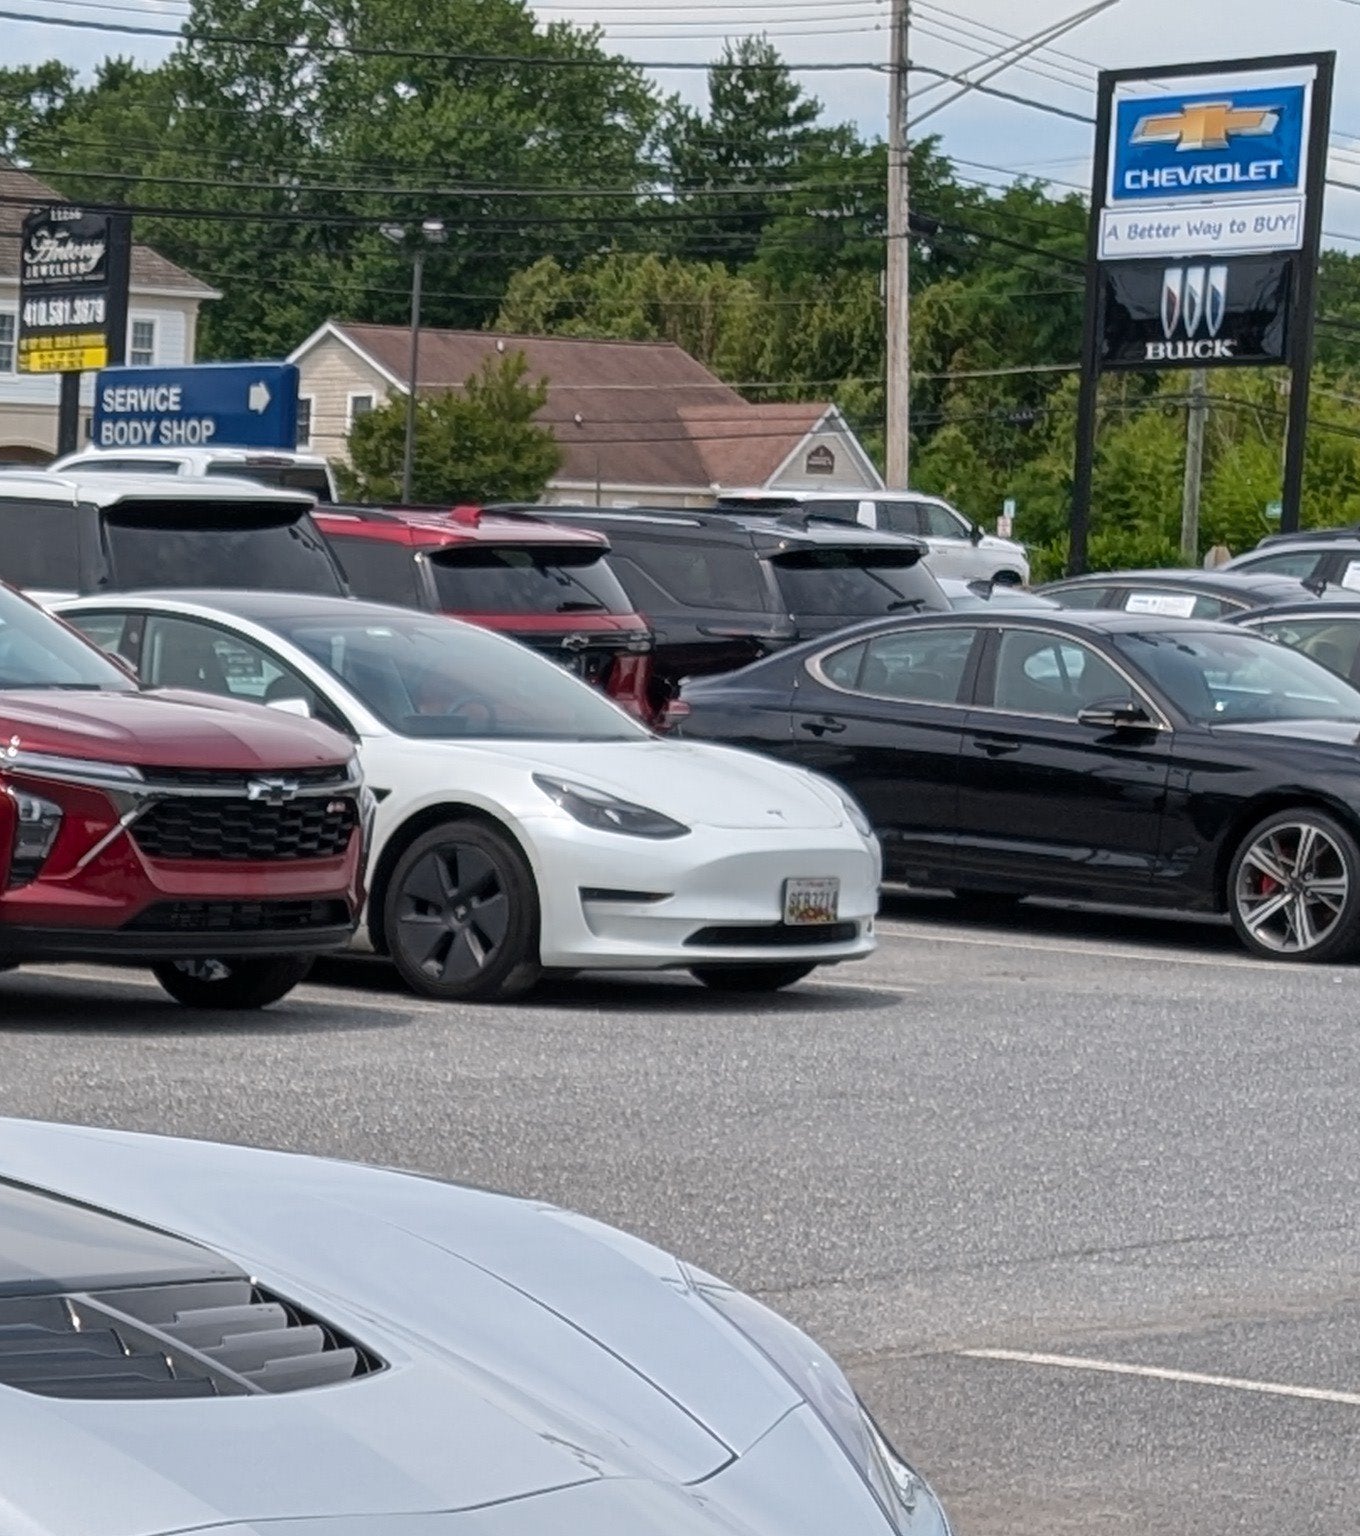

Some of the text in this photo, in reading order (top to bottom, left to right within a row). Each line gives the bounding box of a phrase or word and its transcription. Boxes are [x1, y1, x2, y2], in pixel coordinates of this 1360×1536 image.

[1124, 160, 1283, 189] CHEVROLET
[1105, 214, 1296, 241] A Better Way to BUY!
[1144, 338, 1238, 361] BUICK
[102, 386, 182, 413] SERVICE
[101, 419, 215, 446] BODY SHOP
